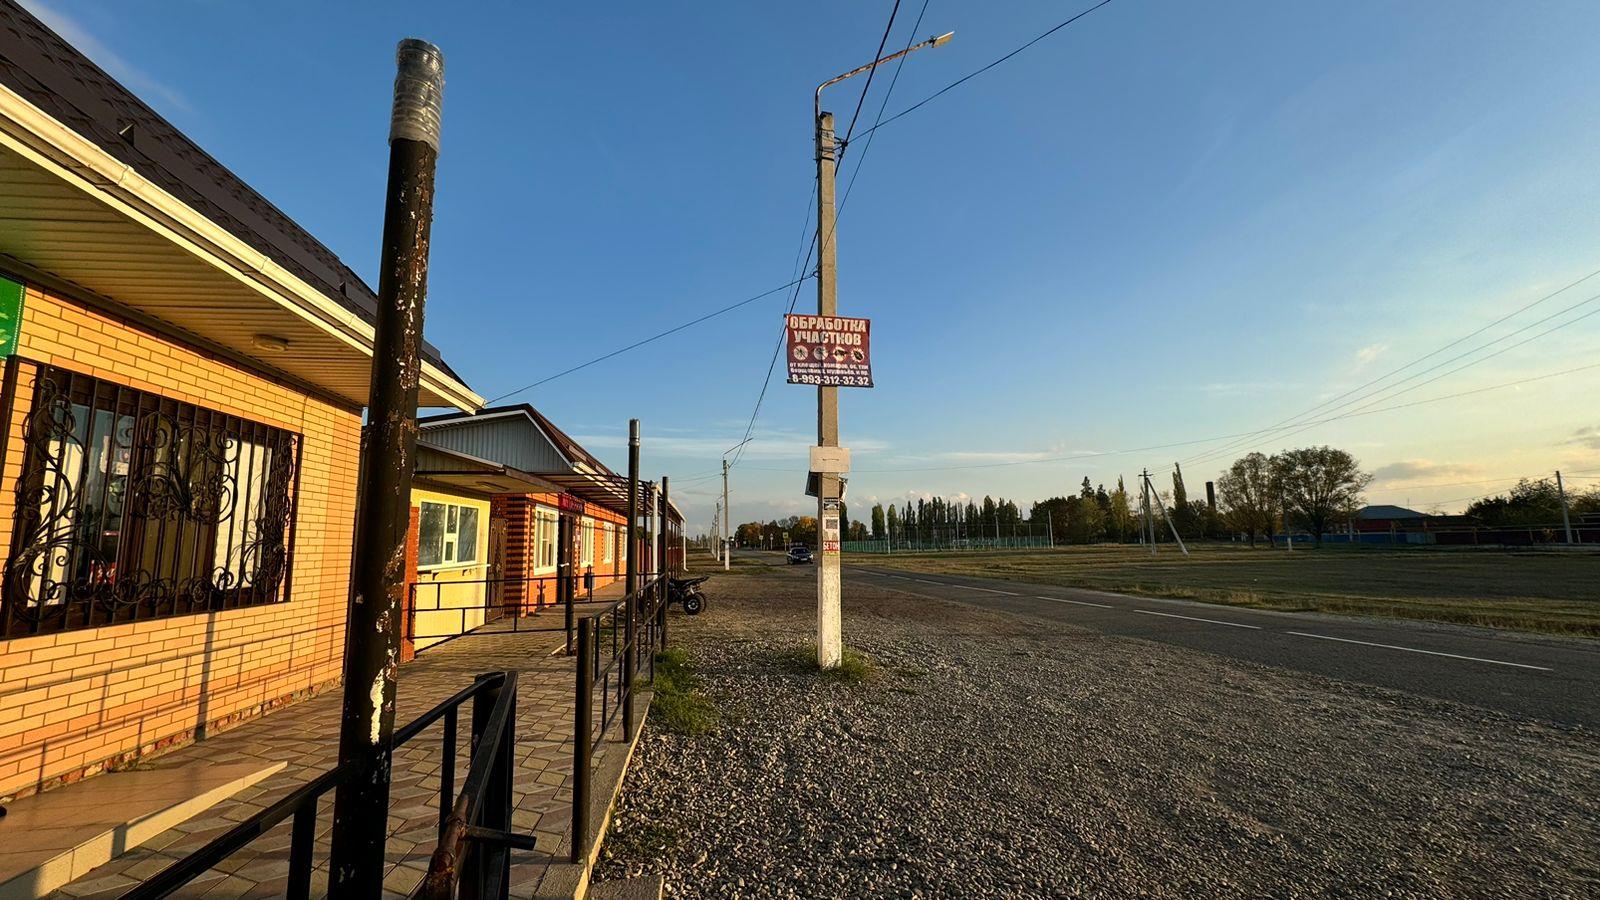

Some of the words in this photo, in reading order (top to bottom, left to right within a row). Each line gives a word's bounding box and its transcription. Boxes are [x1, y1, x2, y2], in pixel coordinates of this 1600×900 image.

[790, 316, 866, 332] ОБРАБОТКА
[794, 331, 862, 346] УЧАСТКОВ
[792, 374, 869, 385] 8-993-312-32-32
